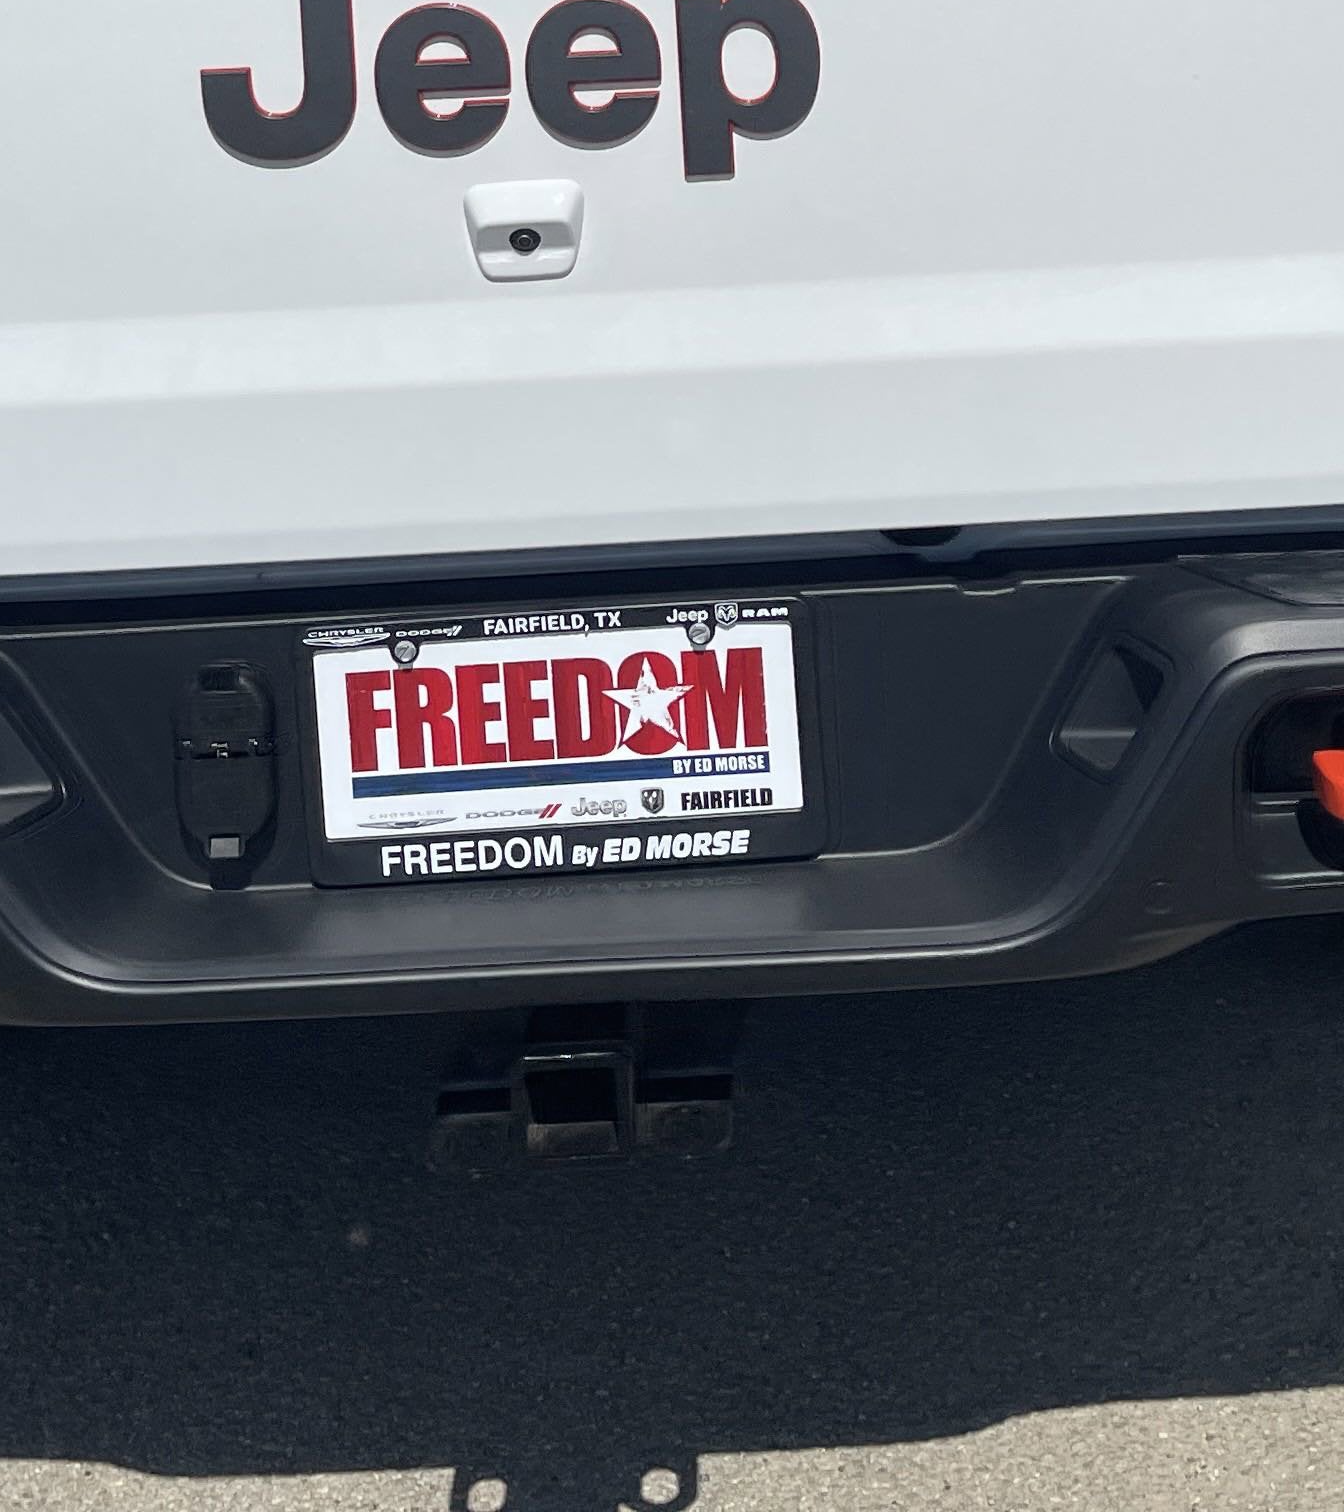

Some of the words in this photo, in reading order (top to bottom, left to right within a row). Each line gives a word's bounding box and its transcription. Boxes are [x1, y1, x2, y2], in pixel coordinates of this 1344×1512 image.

[666, 608, 709, 624] Jeep
[742, 606, 789, 618] RAM
[308, 626, 384, 638] CHRYSLER
[483, 613, 590, 635] FAIRFIELD,
[594, 611, 622, 627] TX
[344, 646, 769, 773] FREEDOM
[672, 759, 692, 775] BY
[694, 757, 713, 773] ED
[715, 754, 766, 772] MORSE
[571, 797, 627, 818] Jeep
[681, 787, 773, 811] FAIRFIELD
[381, 835, 564, 878] FREEDOM
[571, 844, 599, 868] By
[602, 836, 642, 863] ED
[645, 828, 751, 861] MORSE
